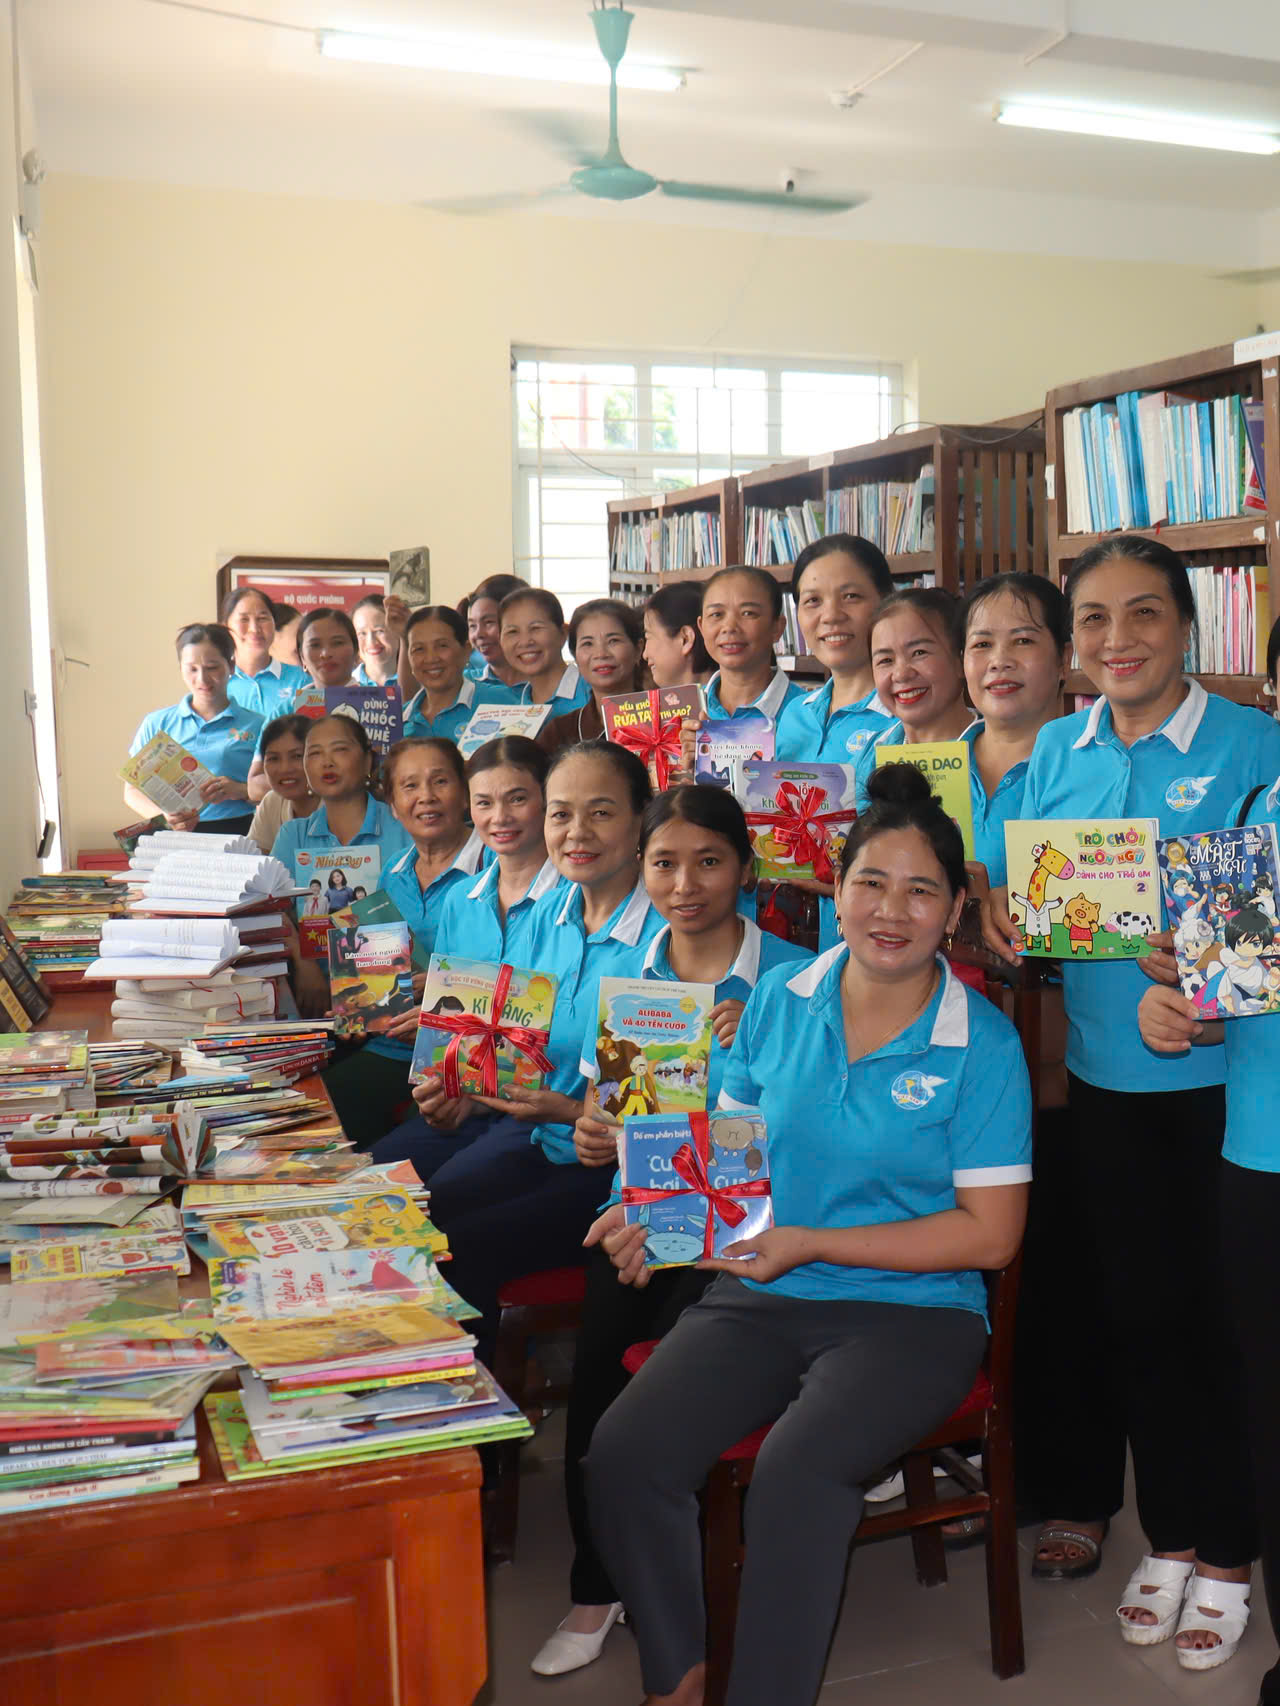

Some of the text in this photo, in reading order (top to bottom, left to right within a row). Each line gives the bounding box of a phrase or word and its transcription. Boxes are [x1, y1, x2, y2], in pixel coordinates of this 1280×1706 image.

[363, 697, 389, 709] ĐỪNG
[360, 709, 397, 727] KHÓC
[613, 711, 637, 728] RỬA
[673, 705, 692, 719] SAO?
[932, 757, 962, 771] DAO
[1074, 826, 1145, 848] TRÒ CHƠI
[1078, 849, 1145, 865] NGÔN NGỮ
[1137, 882, 1146, 893] 2
[472, 996, 534, 1028] KĨ ĂNG
[638, 1009, 673, 1018] ALIBABA
[648, 1020, 663, 1028] TÊN
[633, 1131, 643, 1140] Đố
[649, 1154, 672, 1173] Cu
[265, 1224, 289, 1243] vạn
